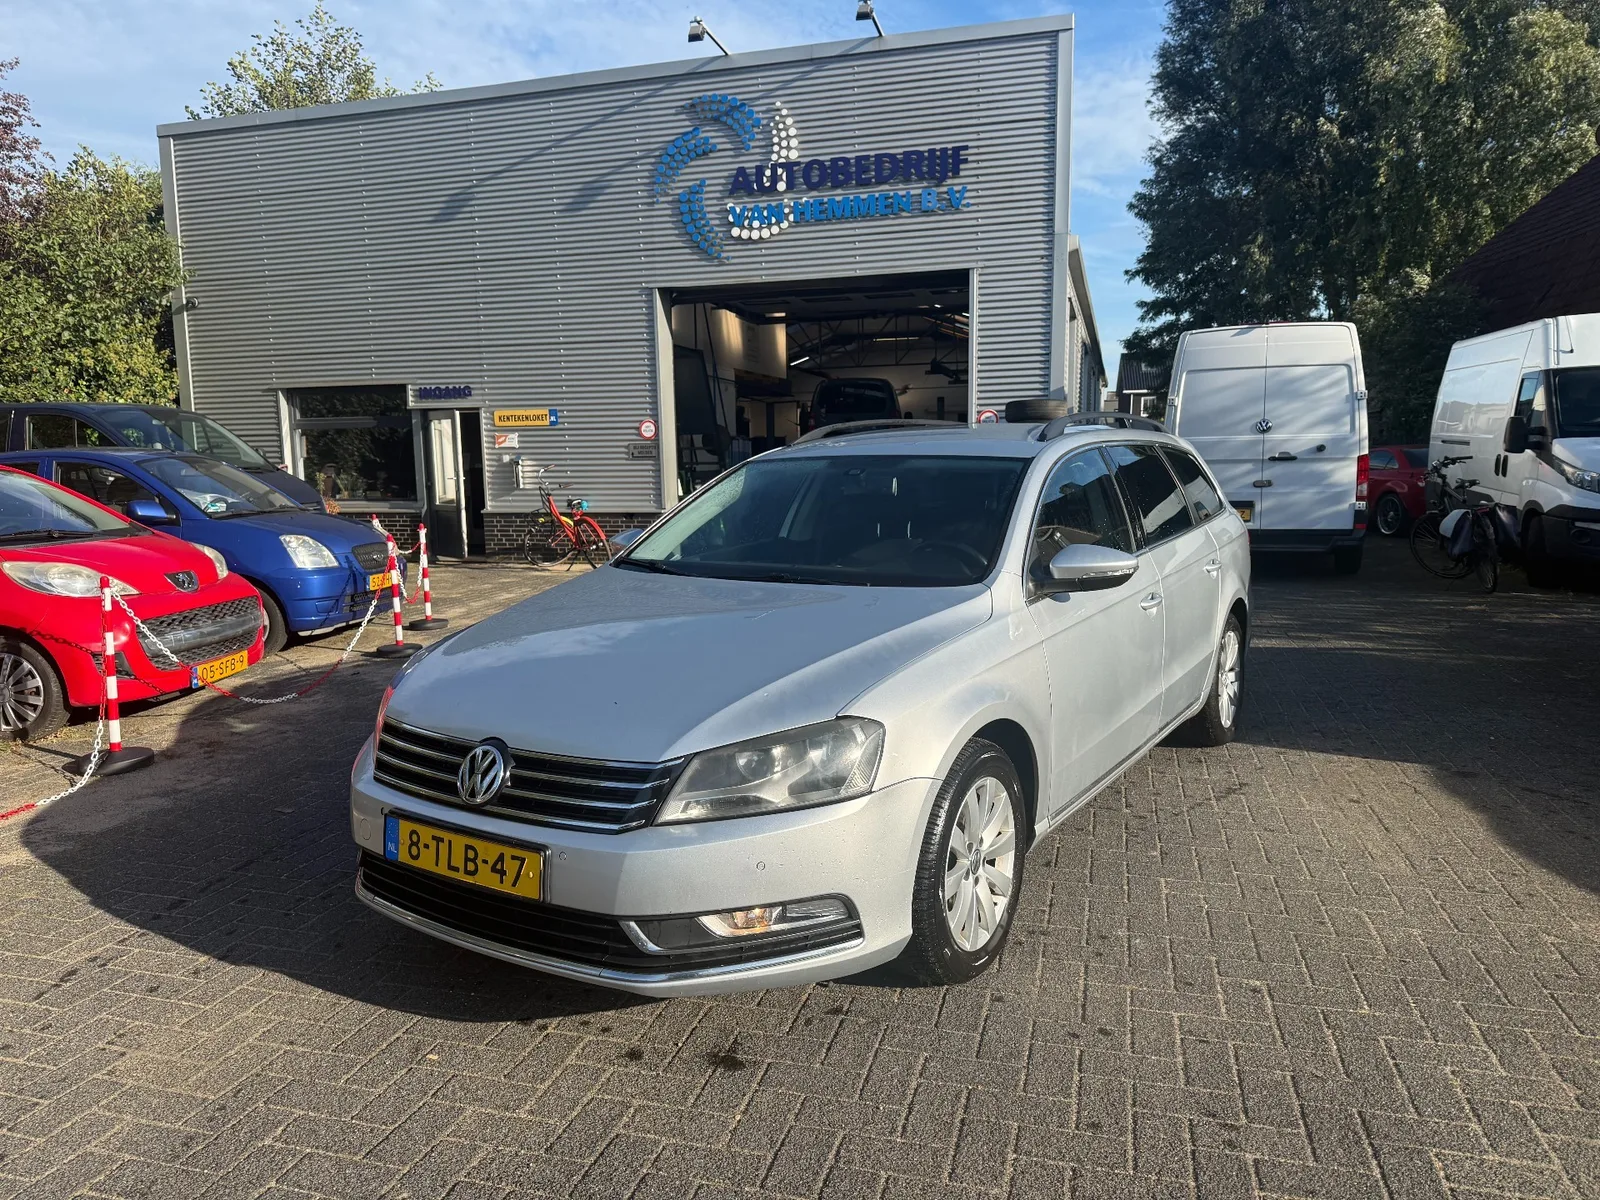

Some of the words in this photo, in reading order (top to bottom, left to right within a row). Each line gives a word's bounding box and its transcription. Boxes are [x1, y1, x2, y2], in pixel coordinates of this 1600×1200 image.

[729, 145, 969, 196] AUTOBEDRIJF
[730, 202, 785, 227] VAN
[793, 190, 911, 223] HEMMEN
[921, 185, 972, 212] B.V.
[419, 385, 472, 400] INGANG
[498, 413, 548, 423] KENTEKENLOKET
[201, 654, 244, 681] 05-SFB-9
[387, 841, 397, 853] NL
[407, 829, 528, 888] 8-TLB-47
